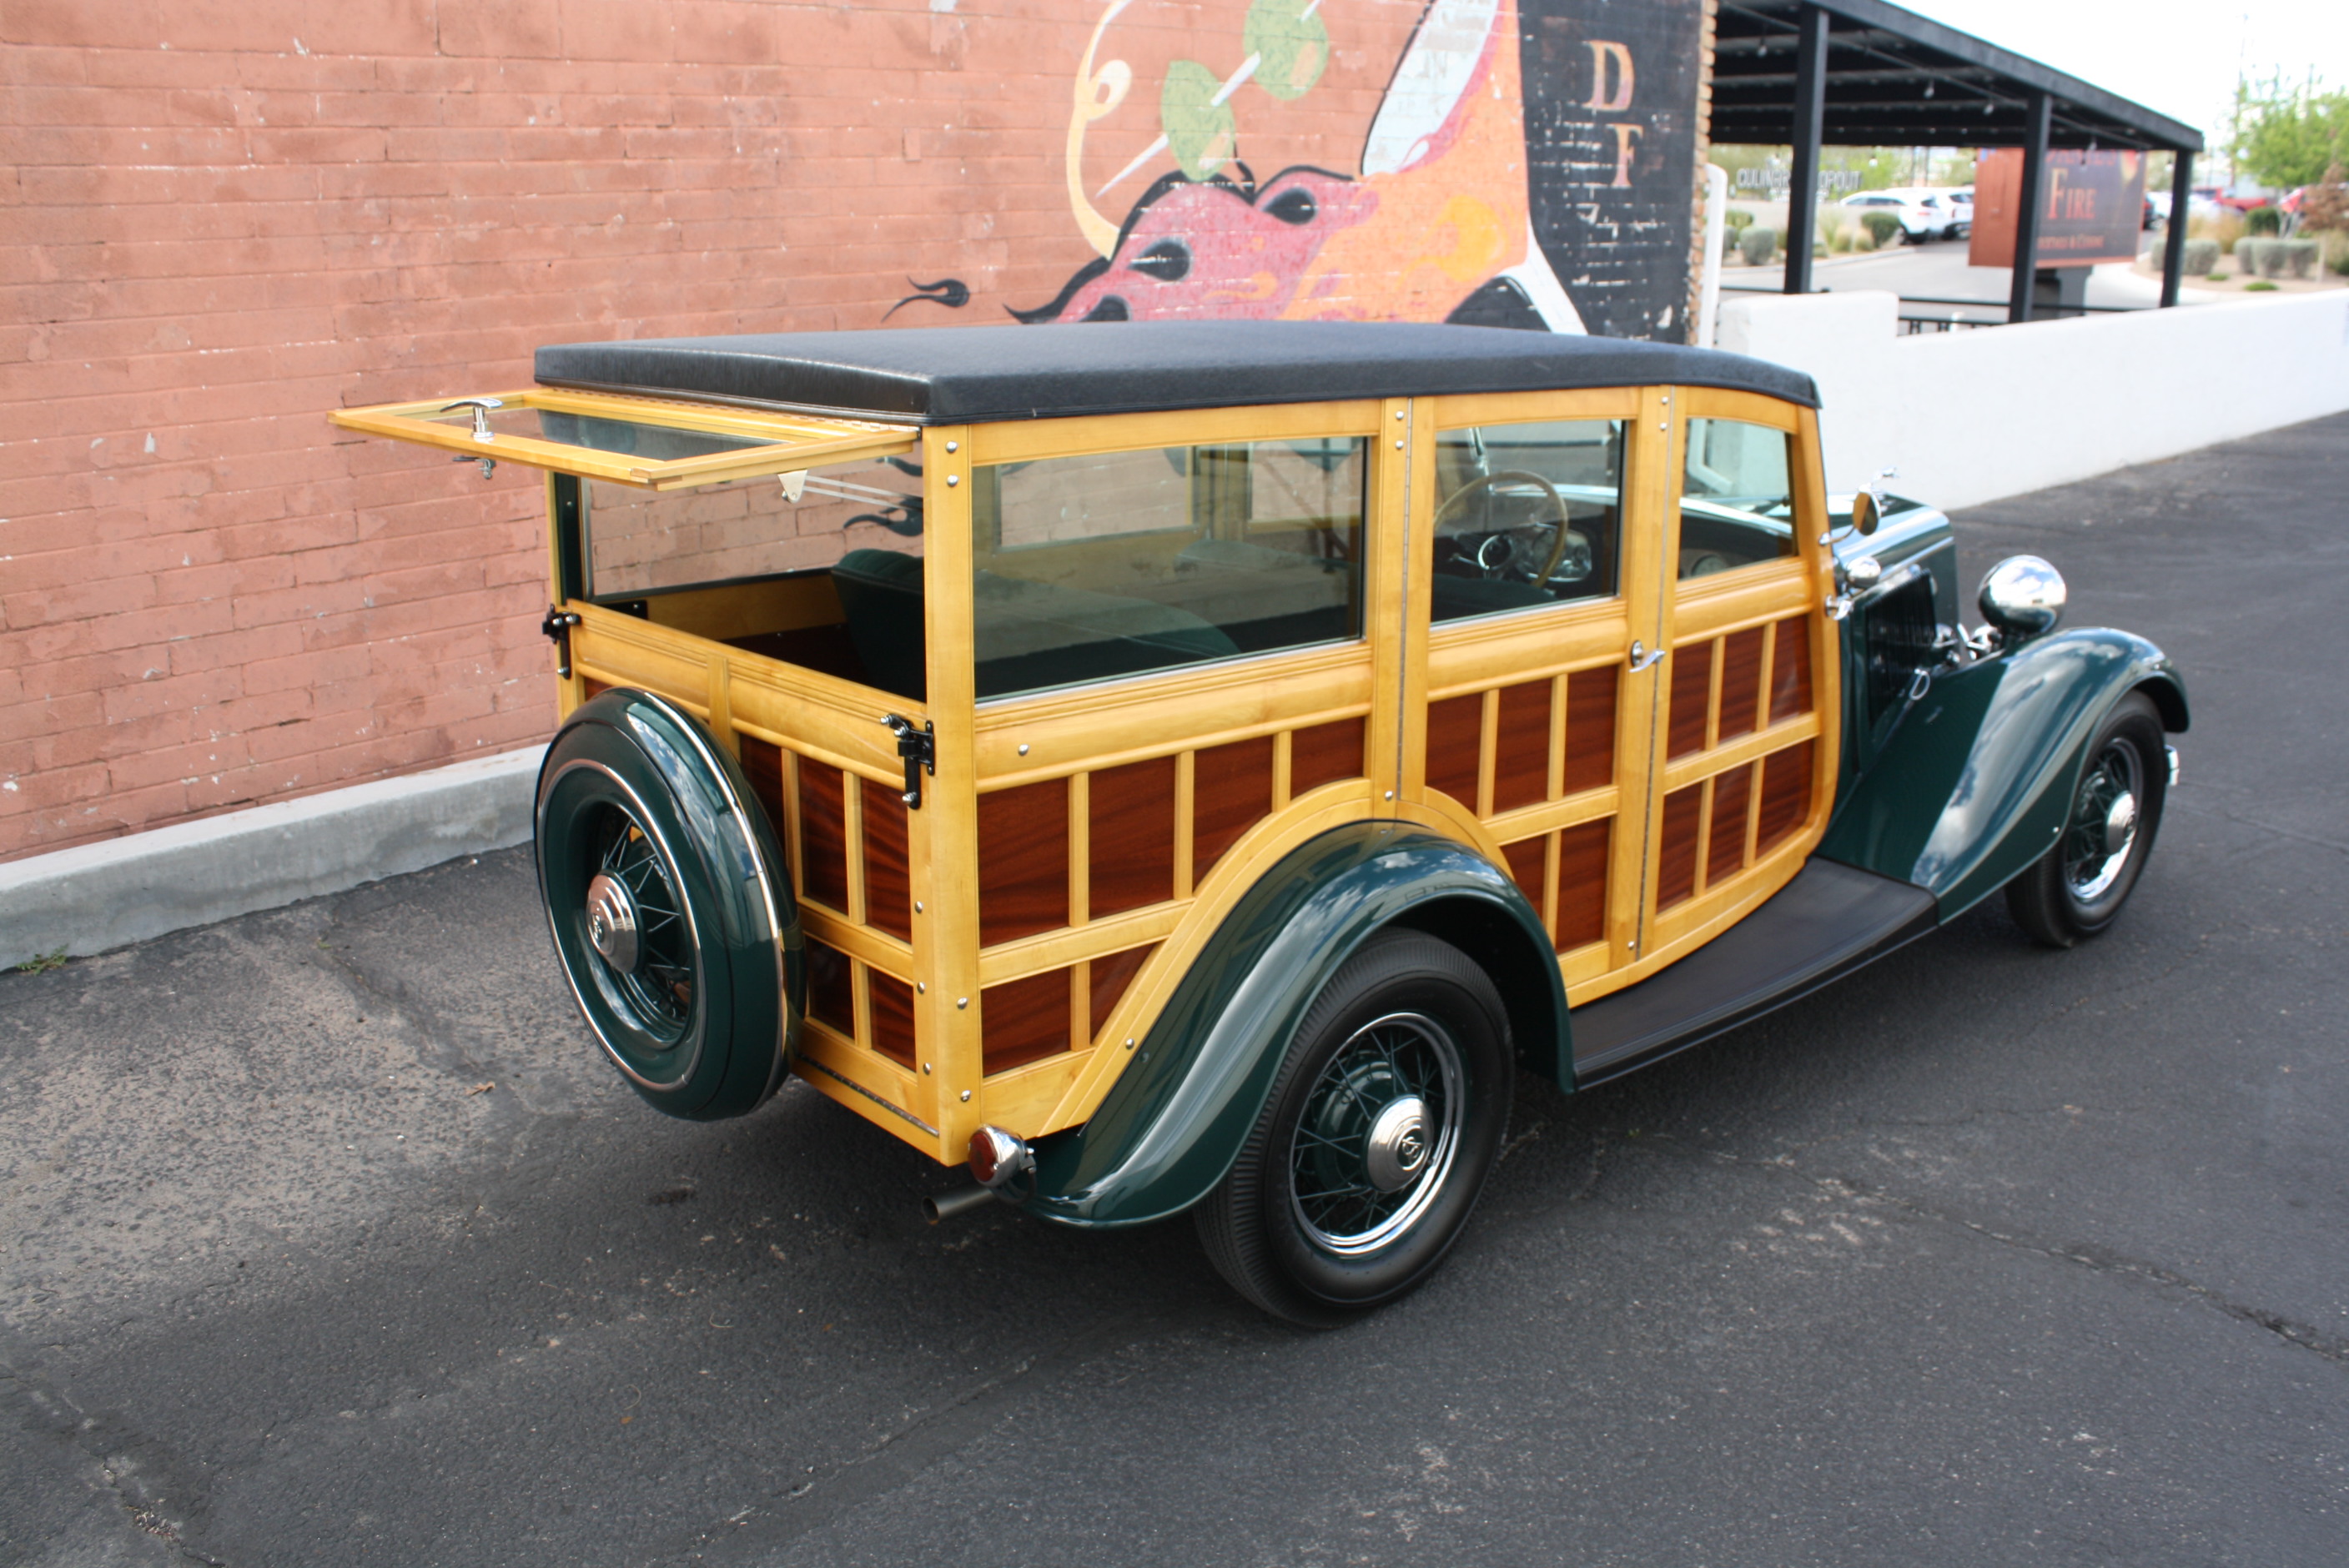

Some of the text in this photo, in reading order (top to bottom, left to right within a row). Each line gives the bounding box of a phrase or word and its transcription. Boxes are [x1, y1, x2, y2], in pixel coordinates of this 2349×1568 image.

[1582, 39, 1635, 112] D
[1606, 123, 1644, 188] F
[1737, 168, 1791, 189] CULINAR
[2048, 168, 2097, 219] FIRE
